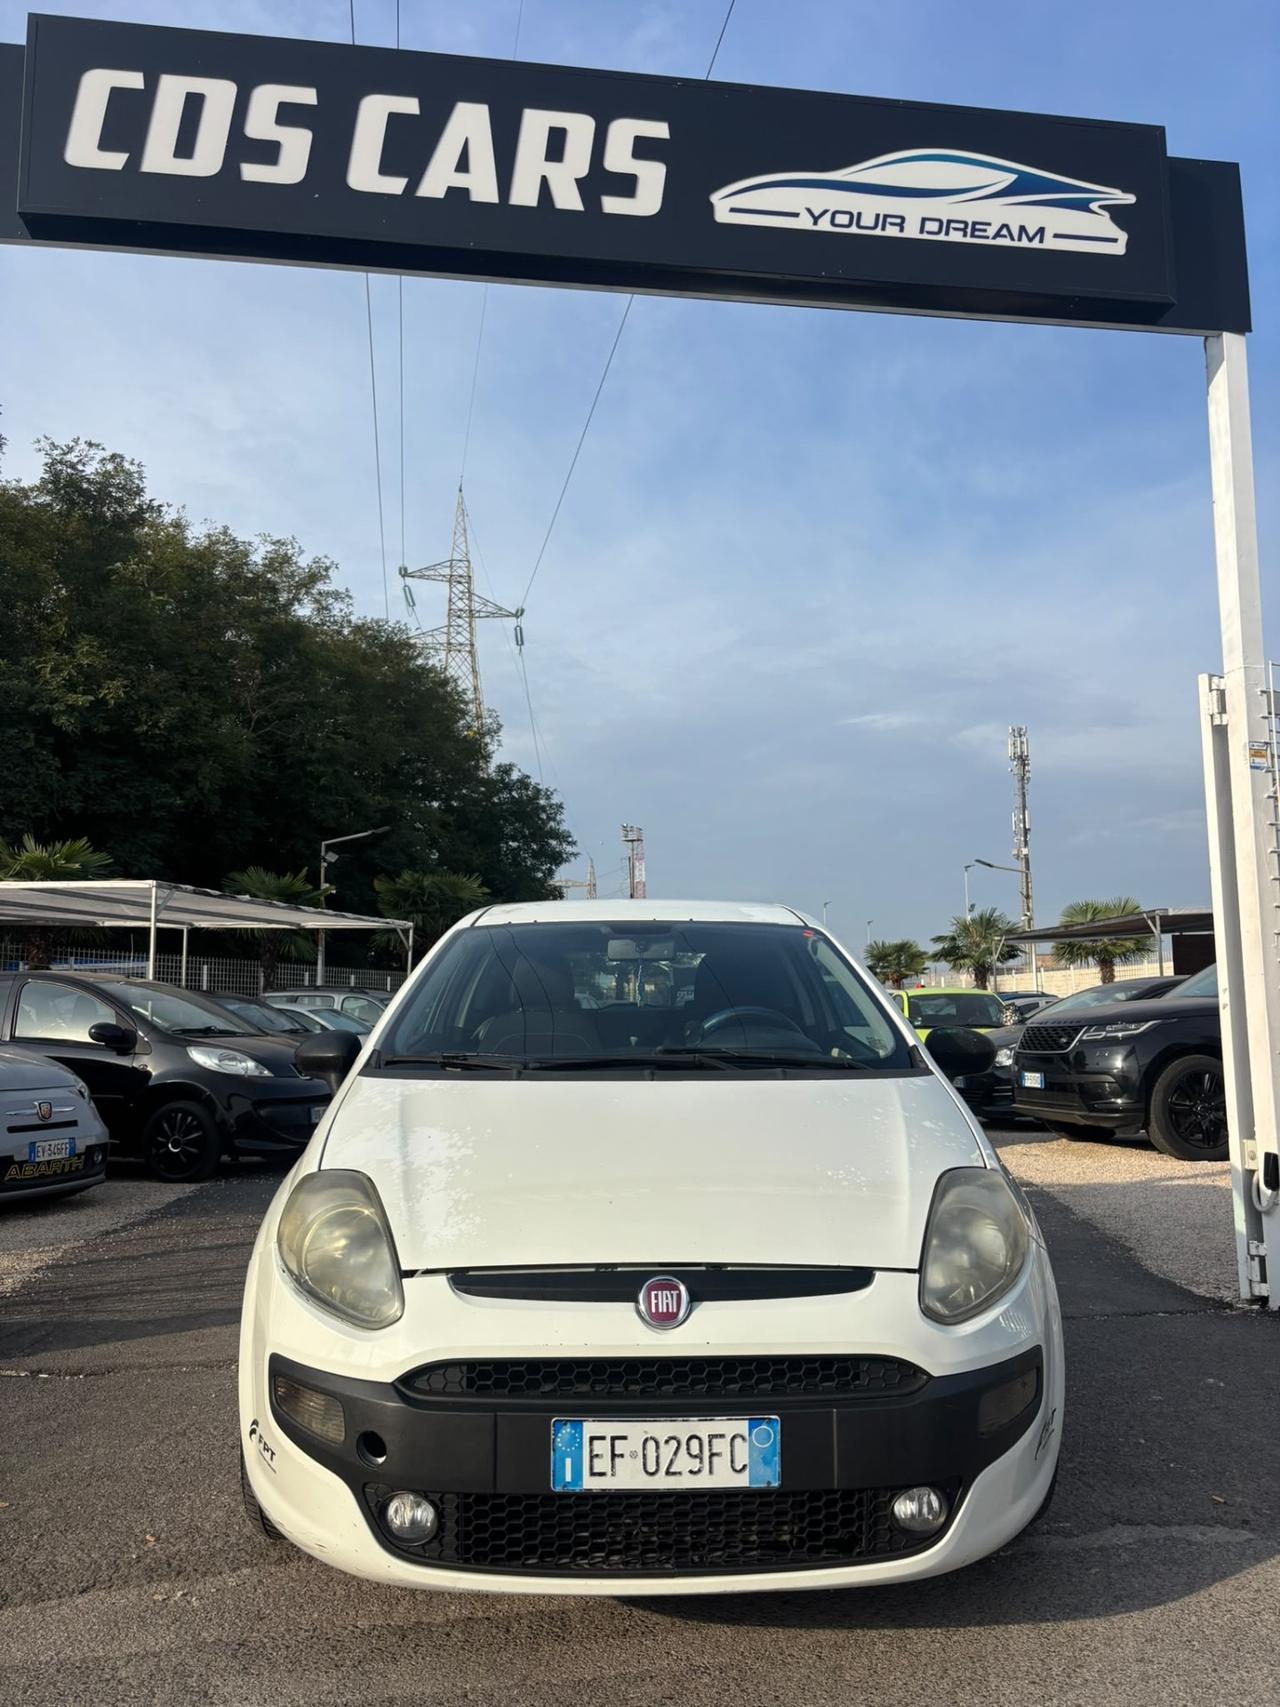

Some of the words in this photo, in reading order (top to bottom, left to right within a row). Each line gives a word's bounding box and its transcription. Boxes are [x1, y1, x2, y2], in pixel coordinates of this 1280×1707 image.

[64, 68, 318, 185] CDS
[346, 94, 671, 217] CARS
[805, 207, 906, 233] YOUR
[919, 216, 1046, 244] DREAM
[4, 1154, 85, 1181] ABARTH
[650, 1290, 680, 1313] FIAT
[588, 1435, 628, 1477] EF
[641, 1433, 748, 1478] 029FC
